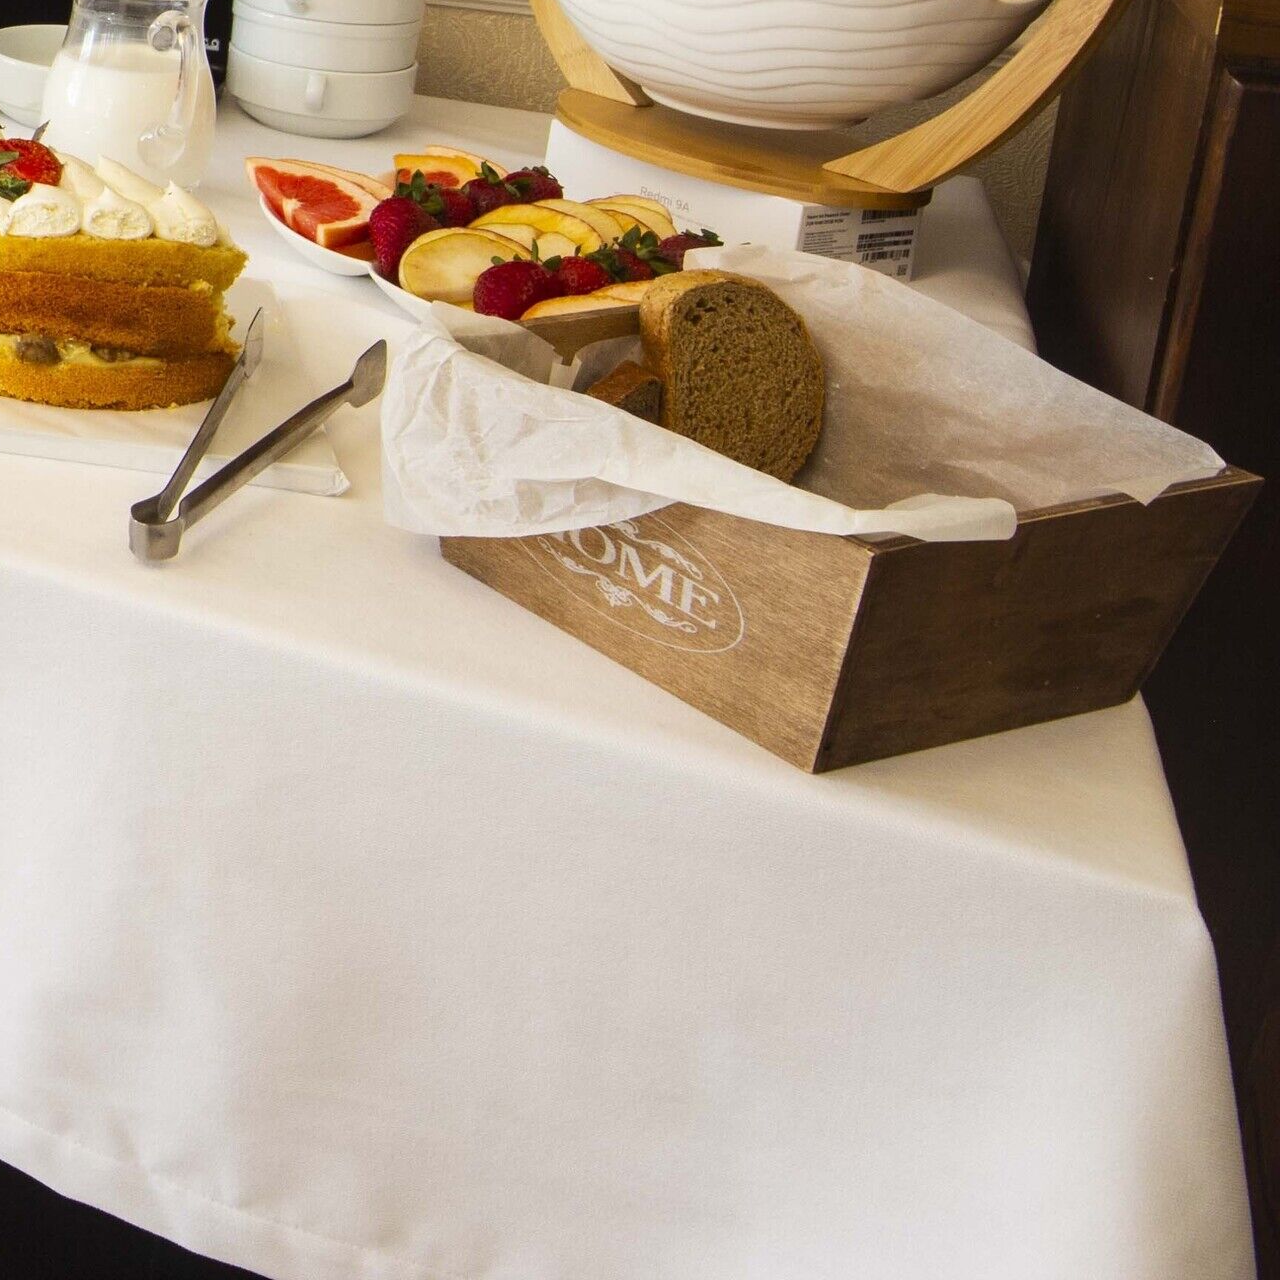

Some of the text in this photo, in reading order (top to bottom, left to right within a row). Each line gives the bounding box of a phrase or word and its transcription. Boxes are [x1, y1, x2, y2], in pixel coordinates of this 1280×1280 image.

[640, 184, 690, 213] Redmi 9A
[551, 524, 719, 629] OME
